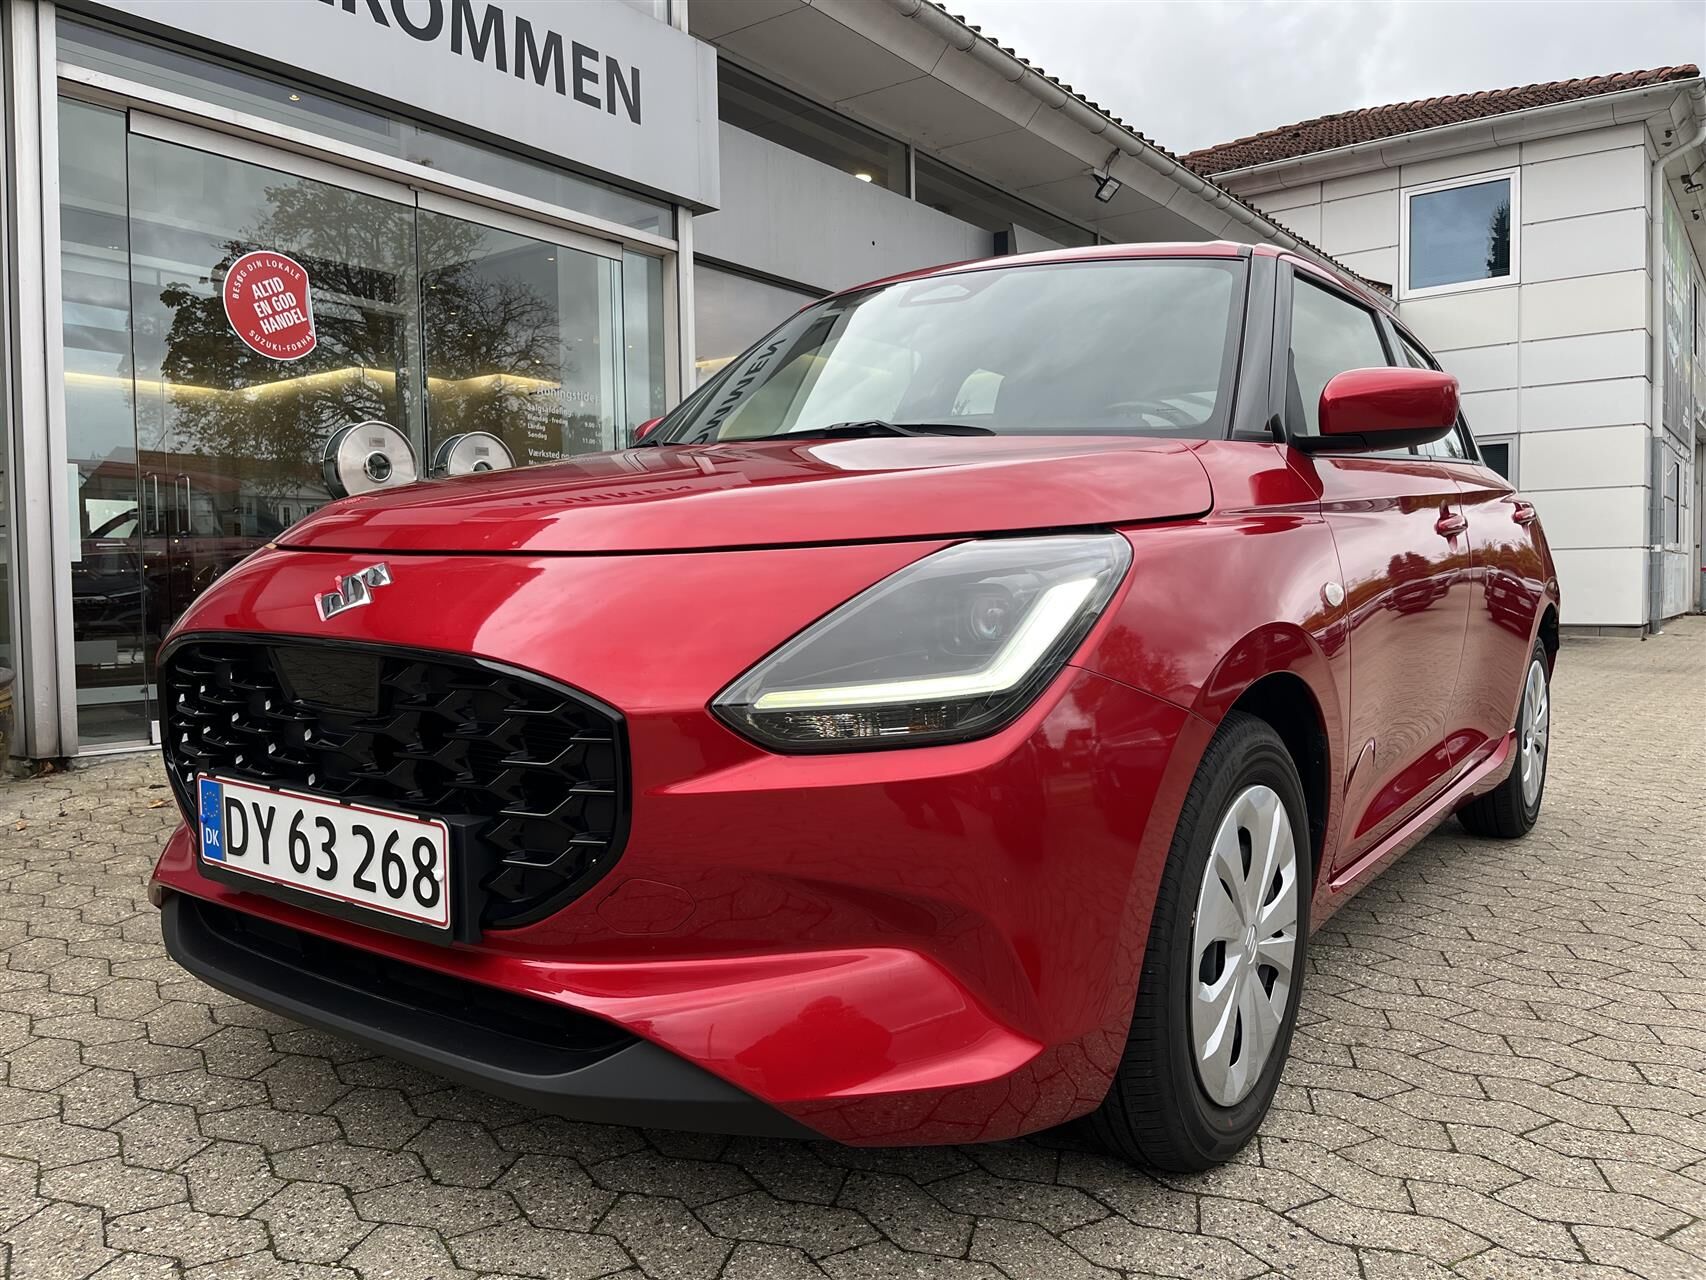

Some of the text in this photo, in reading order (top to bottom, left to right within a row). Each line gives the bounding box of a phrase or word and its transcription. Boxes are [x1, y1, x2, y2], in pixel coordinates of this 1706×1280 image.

[318, 0, 641, 125] OMMEN
[233, 259, 300, 299] BESØG DIN LOKALE
[251, 277, 284, 300] ALTID
[253, 292, 297, 318] EN GOD
[260, 308, 307, 335] HANDEL
[528, 448, 560, 459] Værksted
[205, 827, 219, 847] DK
[225, 796, 440, 908] DY 63 268
